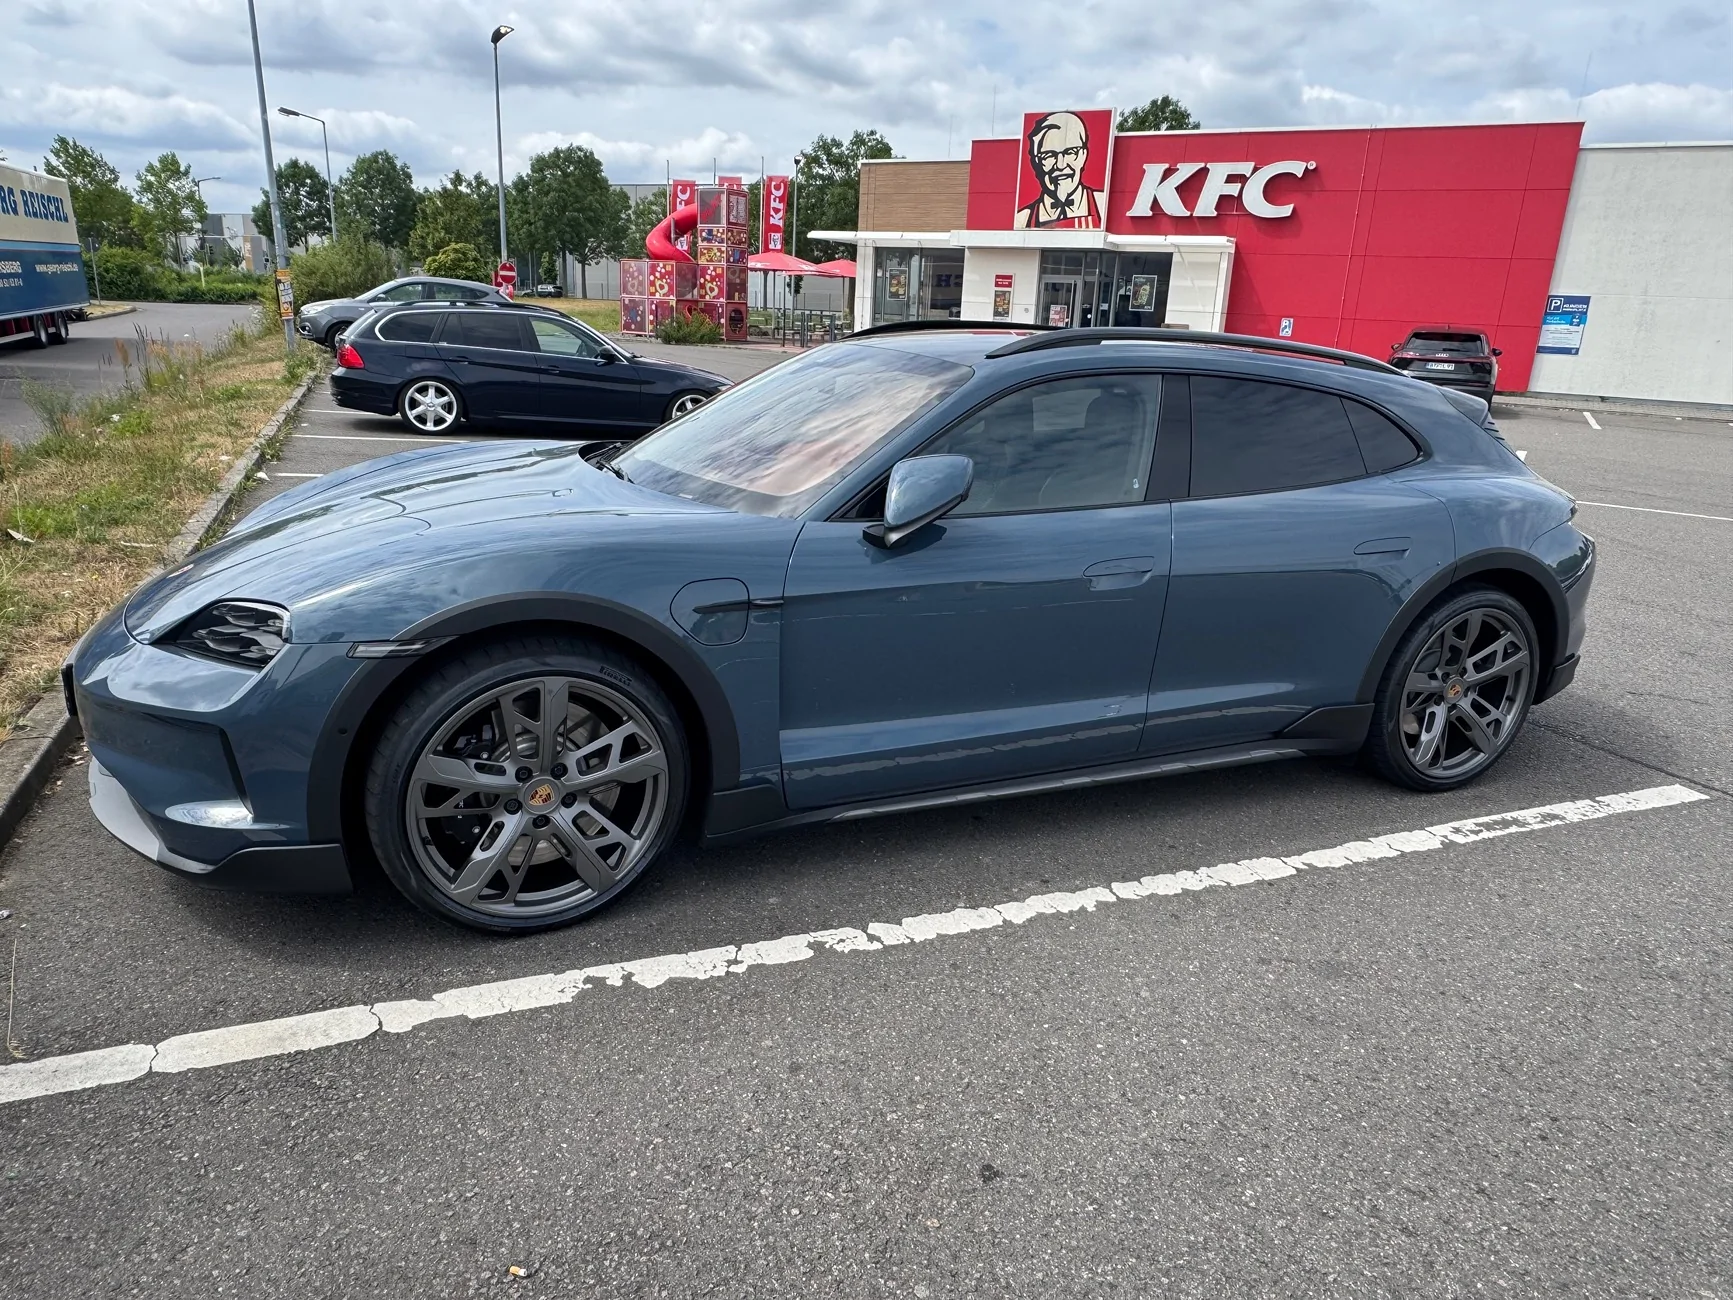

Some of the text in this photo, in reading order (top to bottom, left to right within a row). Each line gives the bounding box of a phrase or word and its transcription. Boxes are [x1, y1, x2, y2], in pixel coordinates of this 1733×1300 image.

[20, 189, 69, 223] REISCHL
[769, 181, 785, 228] KFC
[1126, 160, 1307, 218] KFC
